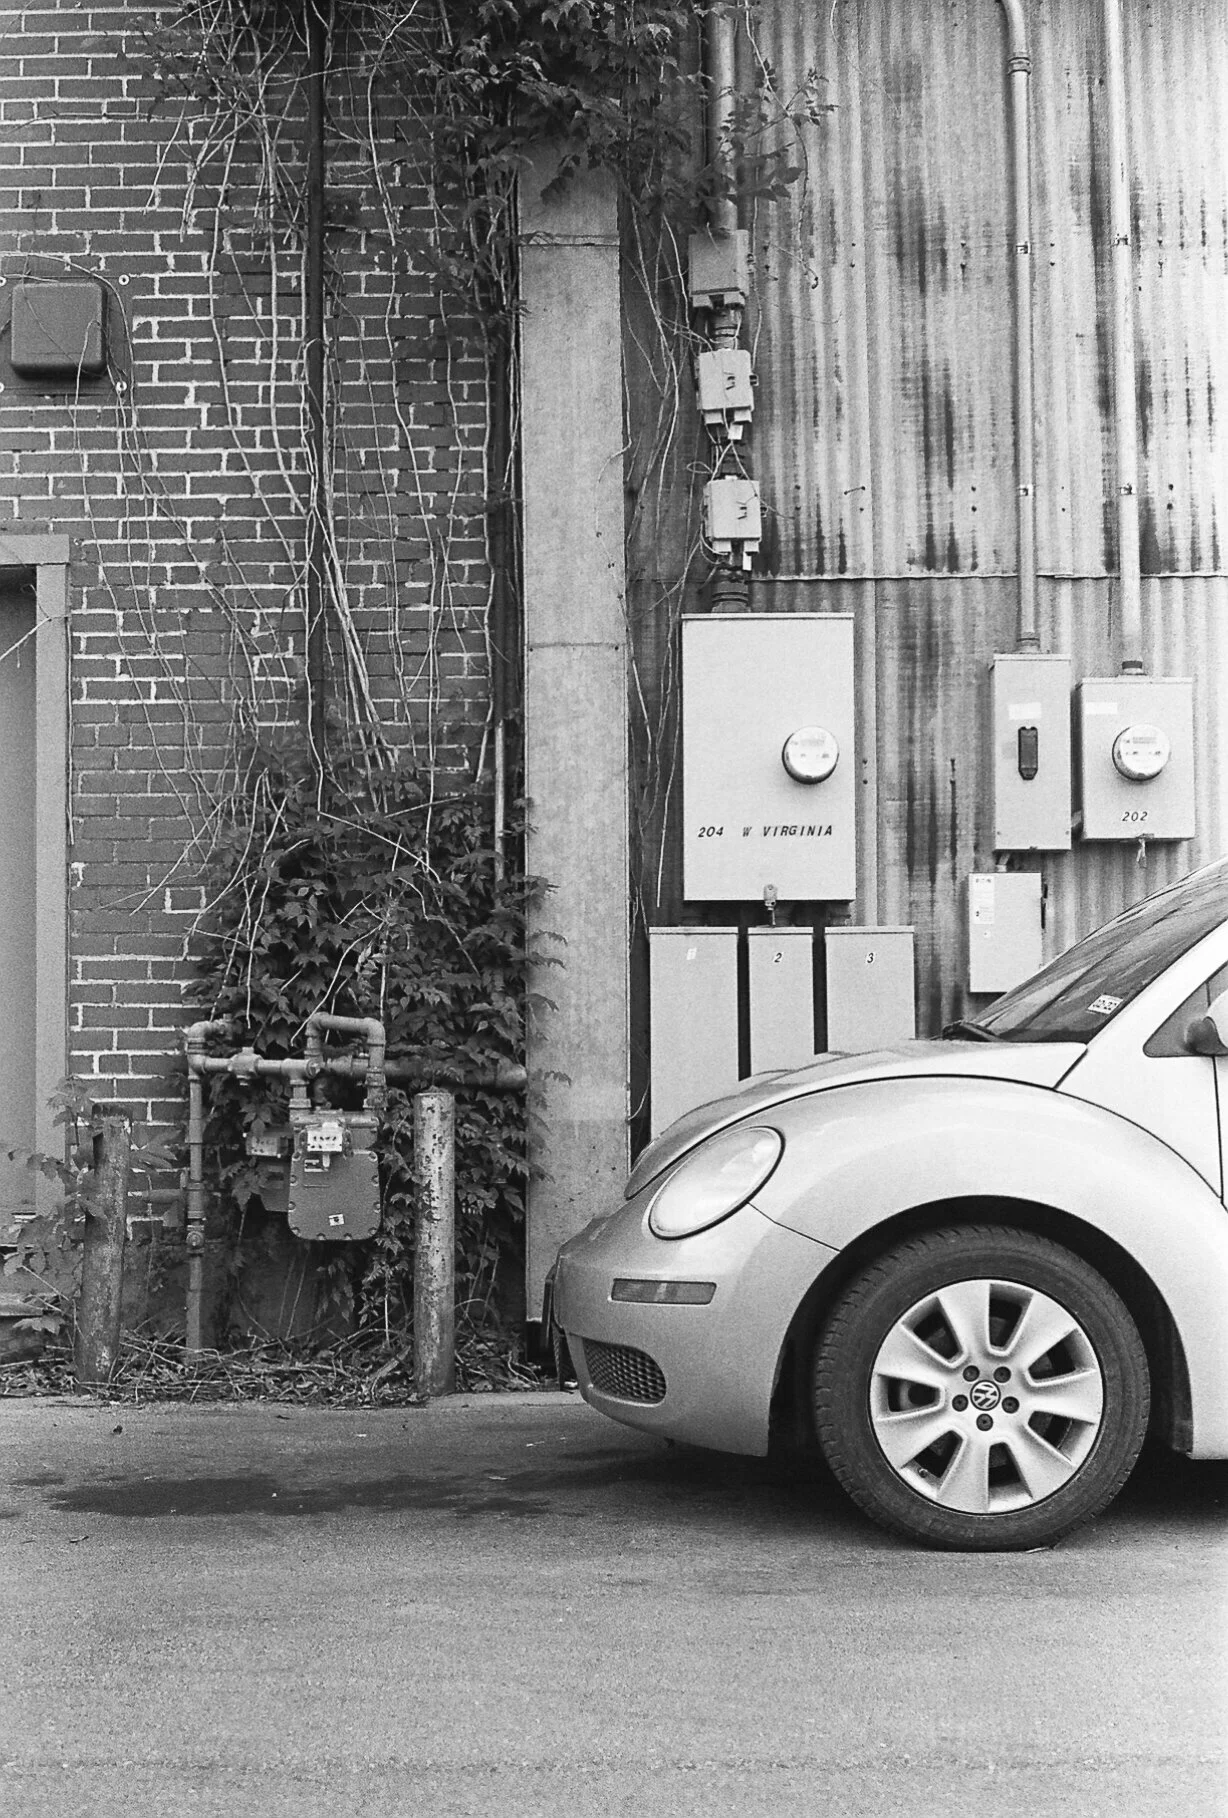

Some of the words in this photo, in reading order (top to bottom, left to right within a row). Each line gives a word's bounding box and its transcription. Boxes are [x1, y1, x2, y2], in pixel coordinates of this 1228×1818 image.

[1121, 810, 1148, 822] 202
[697, 826, 724, 838] 204
[742, 826, 753, 837] W
[763, 825, 833, 837] VIRGINIA
[773, 952, 783, 963] 2
[866, 952, 875, 964] 3
